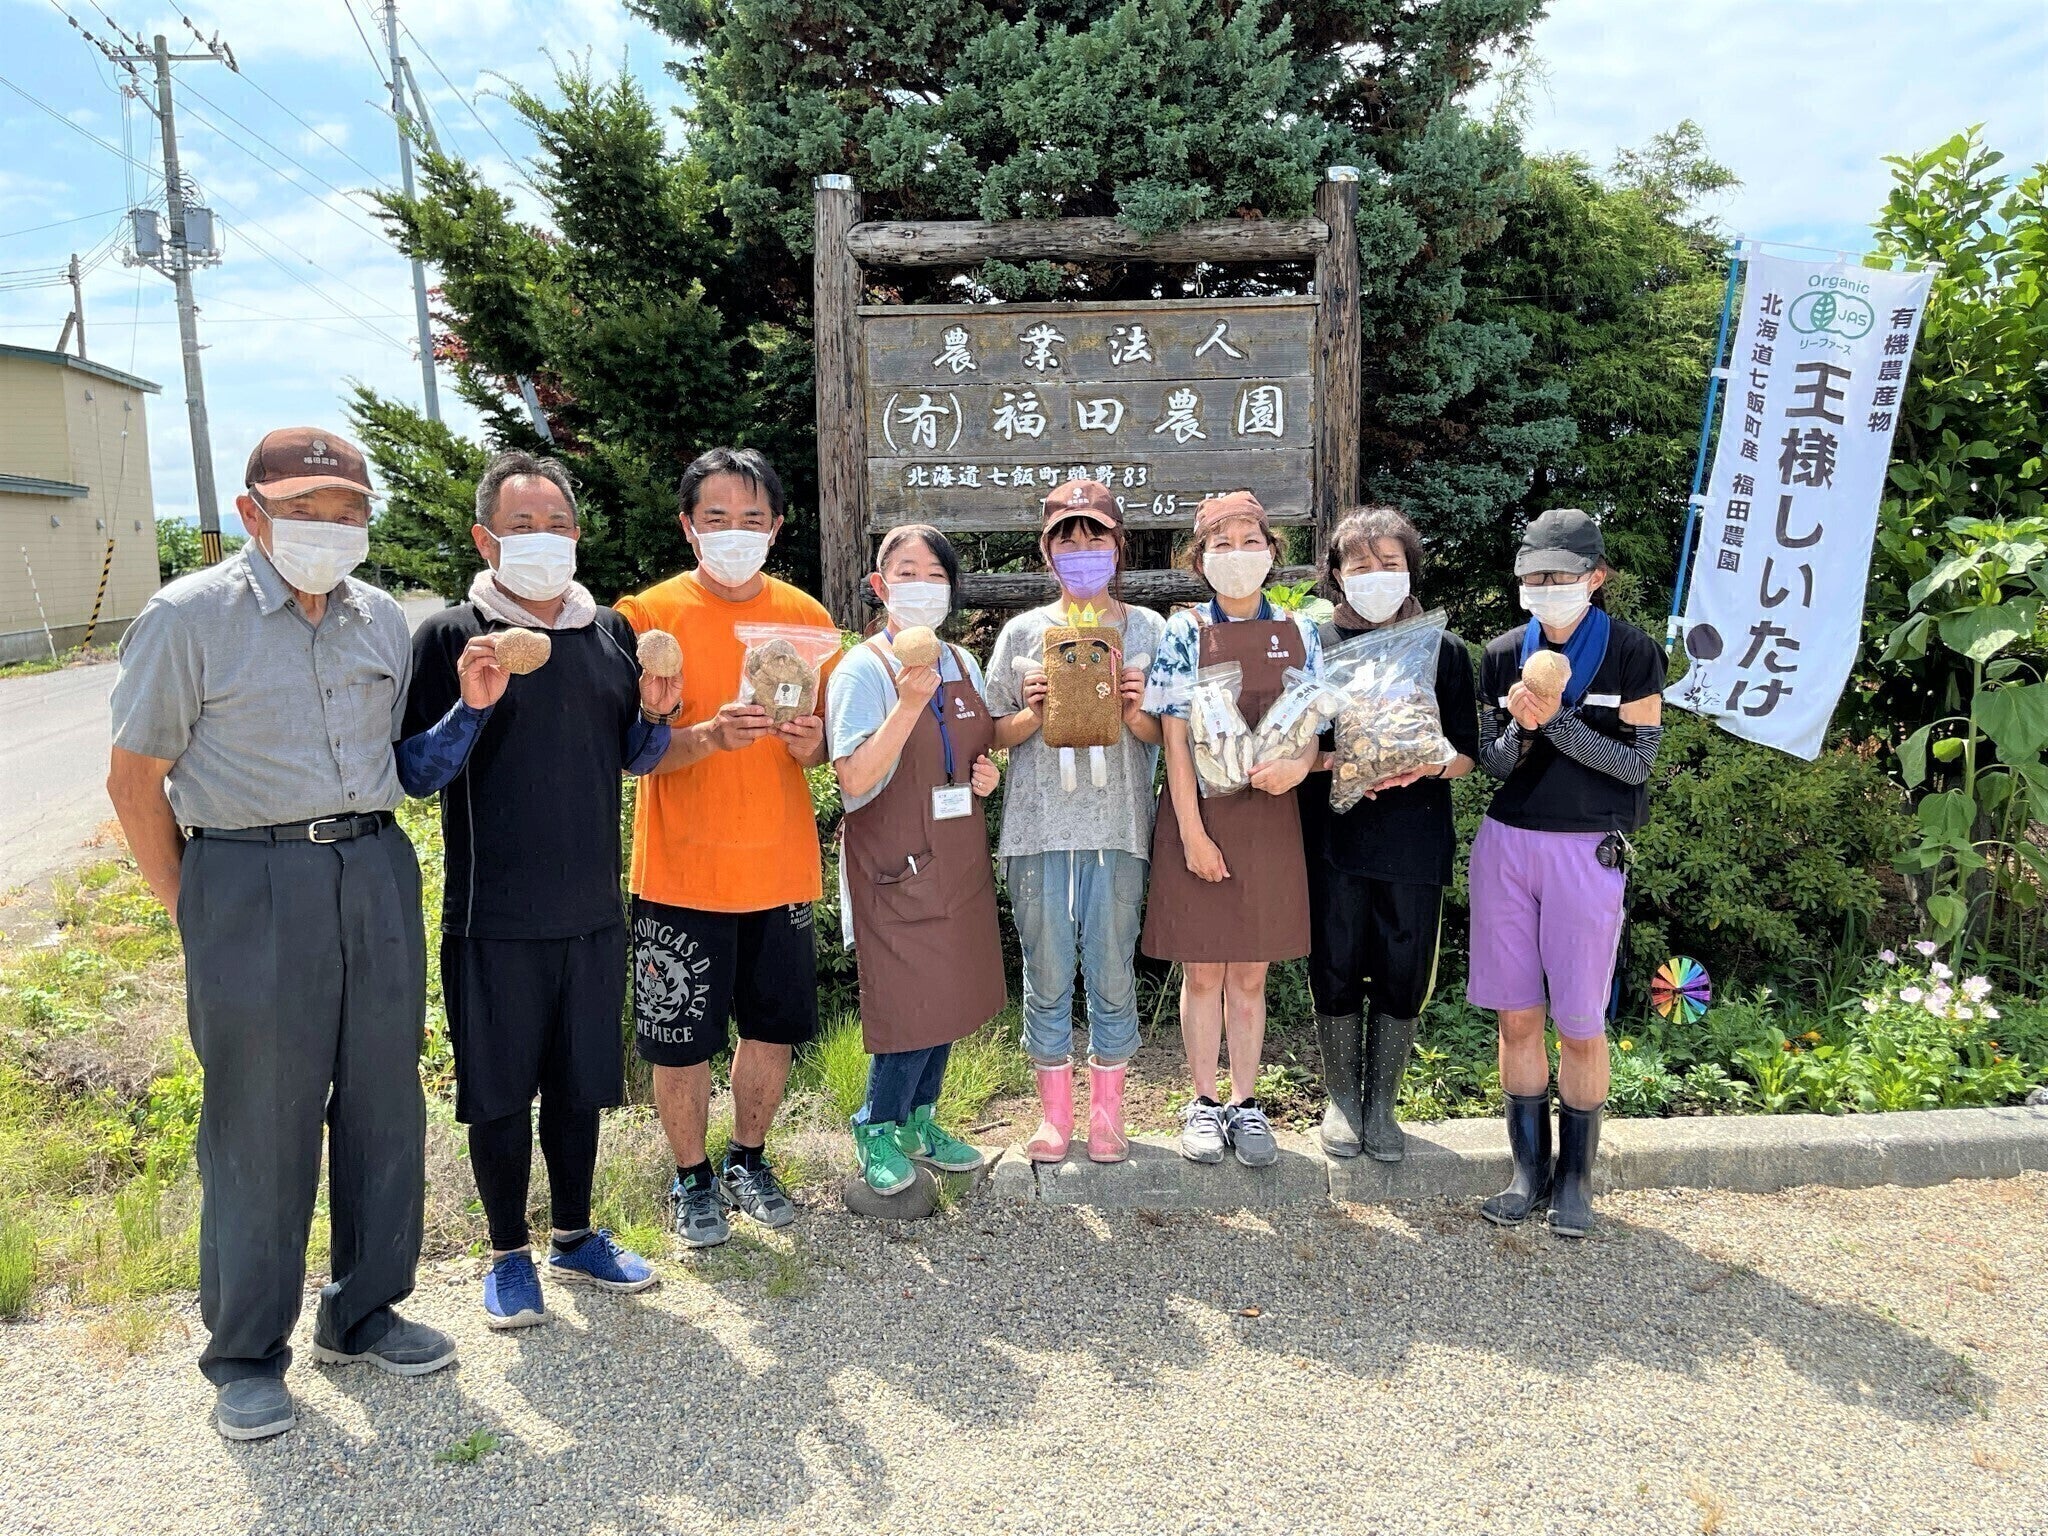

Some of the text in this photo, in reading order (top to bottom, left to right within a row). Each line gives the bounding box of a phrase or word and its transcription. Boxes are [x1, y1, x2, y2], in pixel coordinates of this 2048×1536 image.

[1808, 275, 1870, 294] Organic
[1838, 310, 1868, 327] JAS
[934, 322, 1243, 374] 農業法人
[1800, 338, 1851, 355] リーファース
[1868, 307, 1917, 433] 有機農産物
[1717, 292, 1783, 573] 北海道七飯町産 福田農園
[1725, 361, 1851, 718] 王様しいたけ
[684, 984, 711, 1021] ACE
